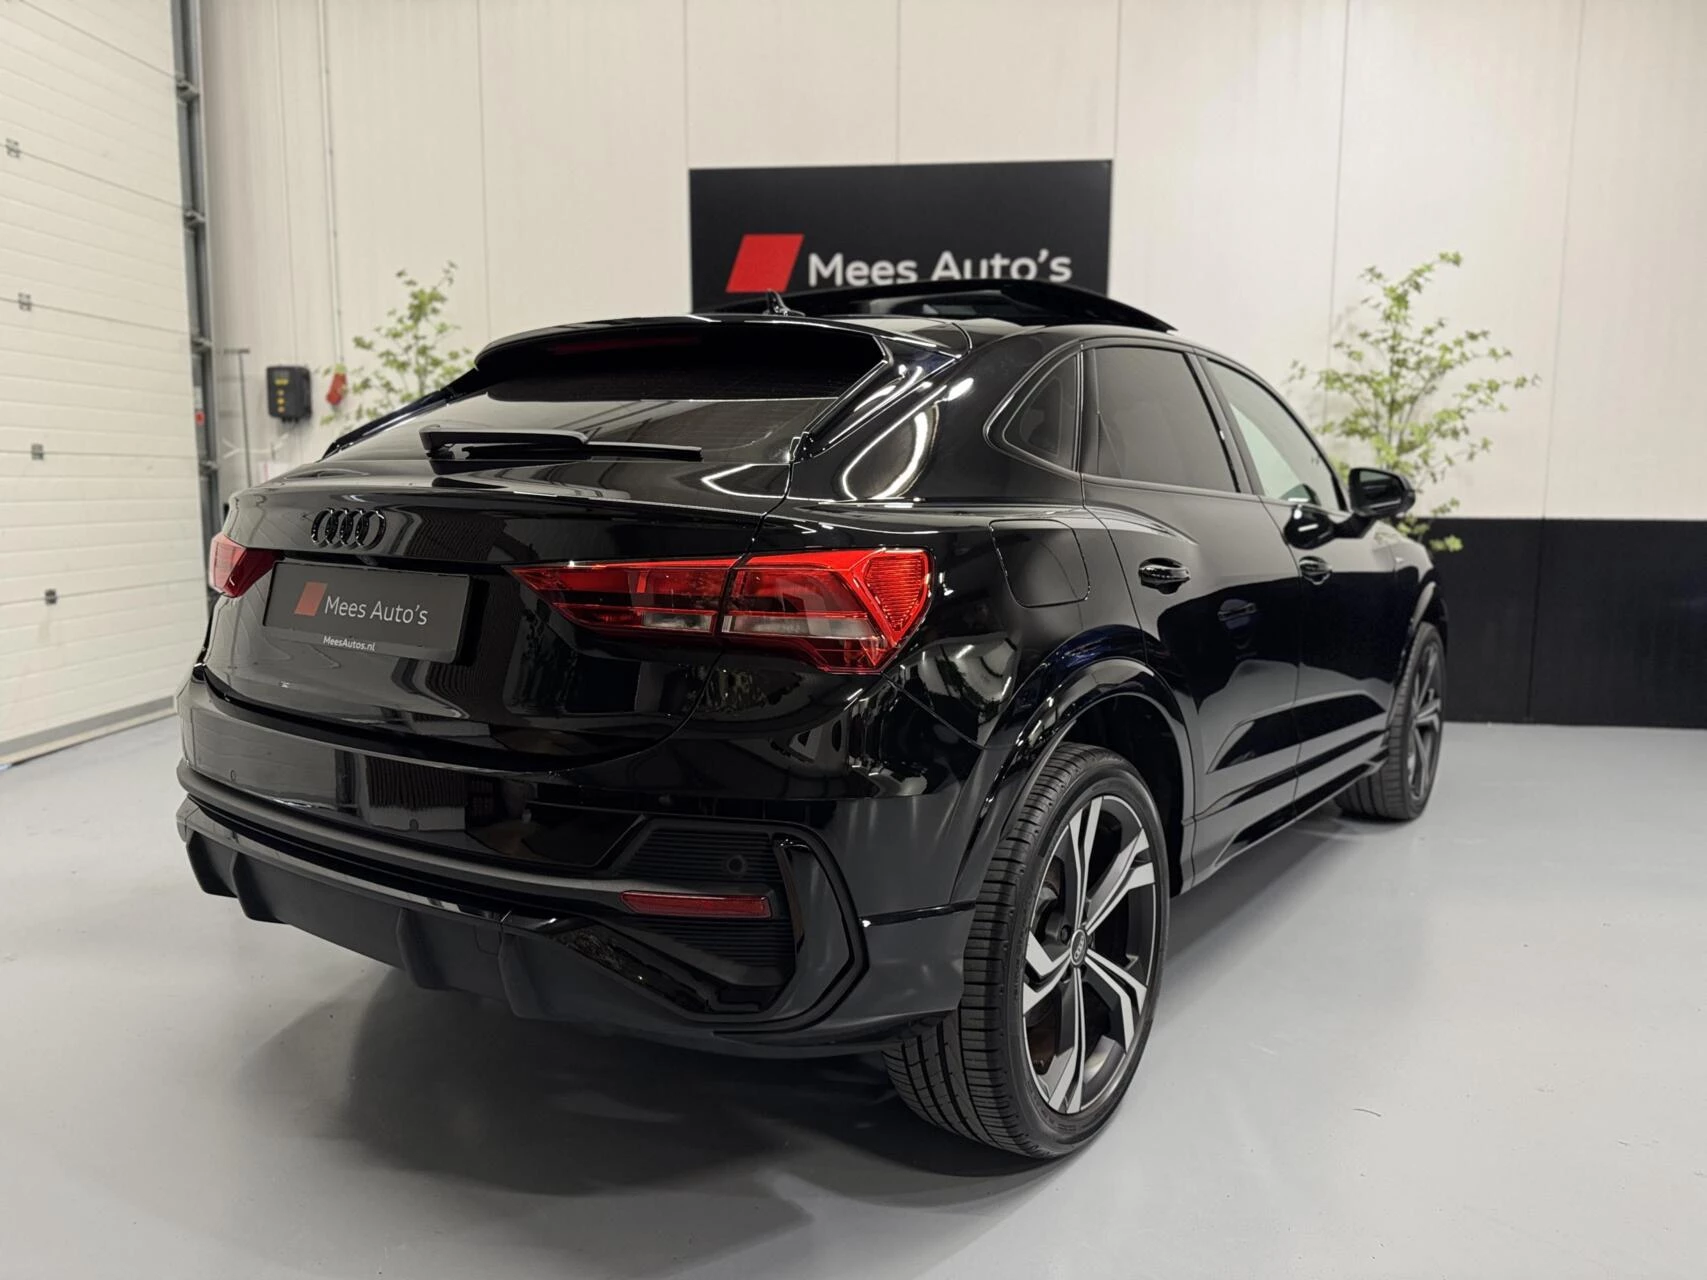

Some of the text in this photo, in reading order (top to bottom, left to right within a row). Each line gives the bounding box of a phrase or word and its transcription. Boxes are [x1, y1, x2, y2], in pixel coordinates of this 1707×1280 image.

[808, 249, 1073, 287] Mees Auto's
[324, 595, 429, 626] Mees Auto's
[323, 635, 376, 651] MeesAutos.nl
